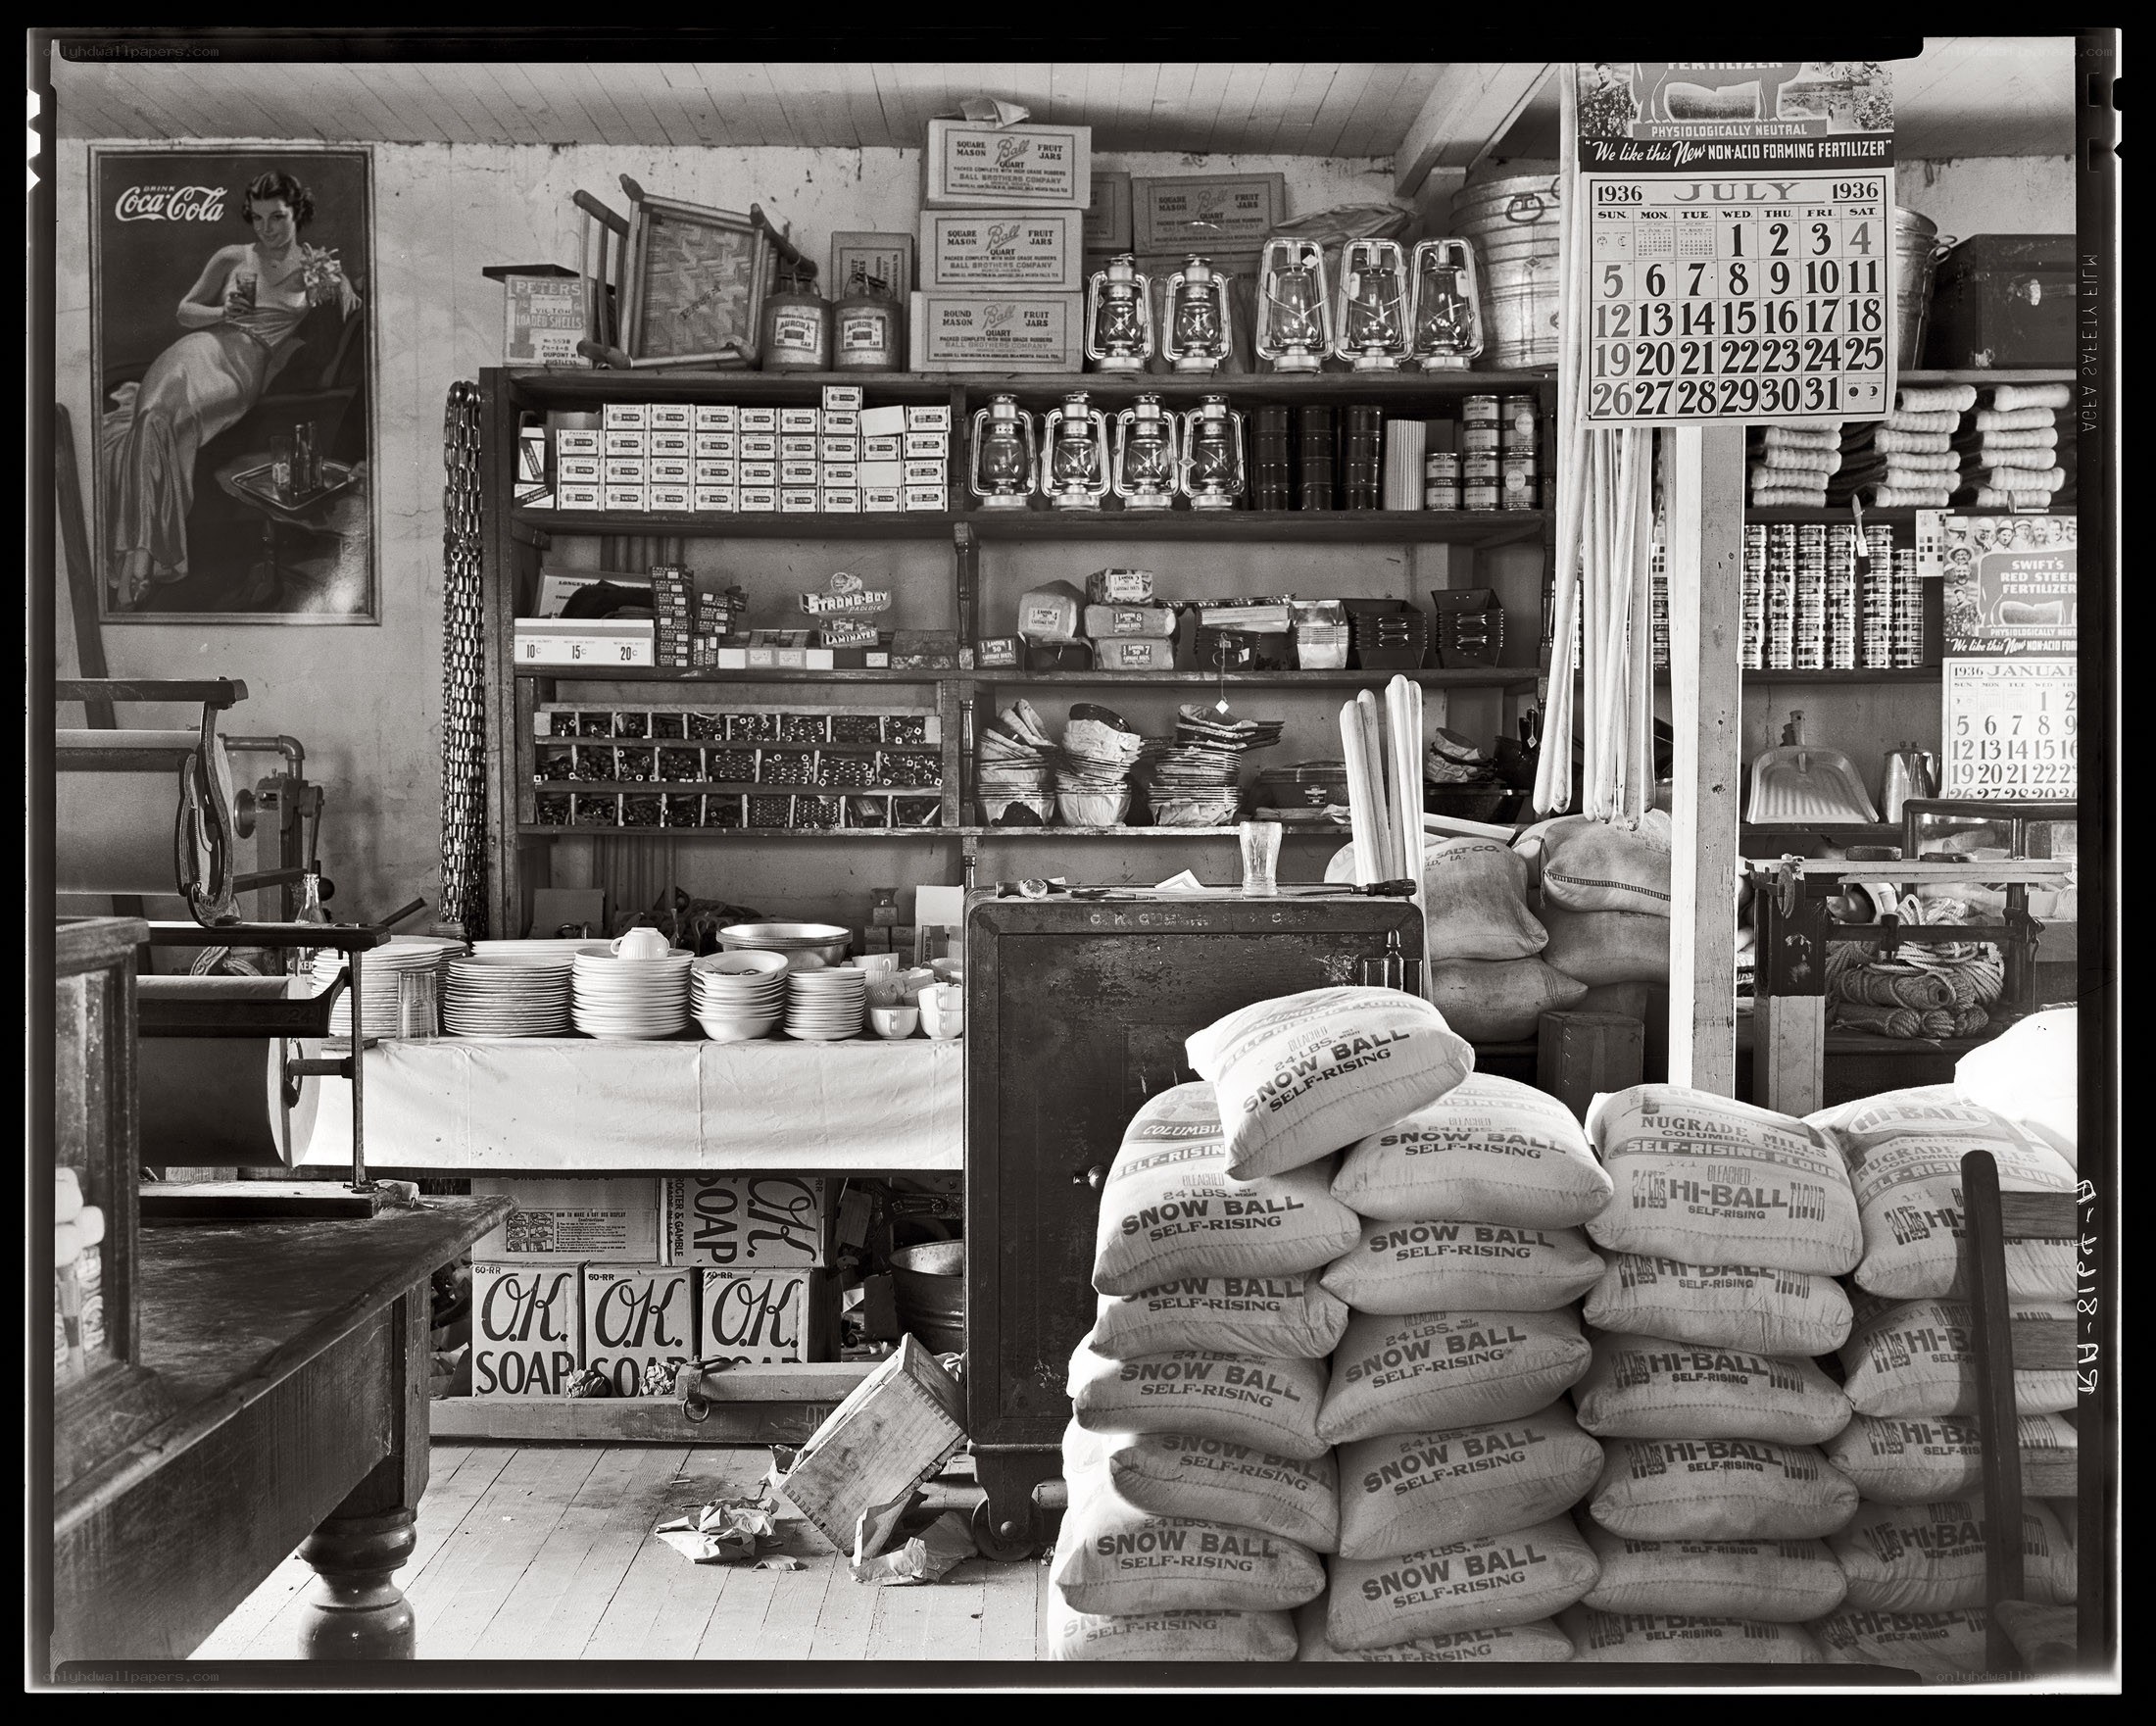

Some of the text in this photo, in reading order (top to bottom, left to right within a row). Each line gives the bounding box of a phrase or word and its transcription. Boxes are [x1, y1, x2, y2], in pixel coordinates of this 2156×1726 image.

[1651, 123, 1807, 138] PHYSIOLOGICALLY NEUTRAL
[995, 137, 1030, 165] Ball
[1619, 144, 1645, 162] like
[1645, 142, 1672, 161] this
[1671, 141, 1706, 167] New
[1763, 143, 1814, 159] FORMING
[115, 185, 227, 222] Coca-Cola
[1597, 182, 1879, 203] 1936 JULY 1936
[1732, 222, 1871, 257] 1 2 3 4
[516, 281, 581, 295] PETERS
[1603, 259, 1879, 298] 5 6 7 8 9 10 11
[516, 315, 583, 328] LOADED SHELLS
[779, 321, 811, 331] AURORA
[1595, 298, 1882, 338] 12 13 14 15 16 17 18
[1594, 337, 1884, 377] 19 20 21 22 23 24 25
[1592, 376, 1839, 417] 26 27 28 29 30 31
[2012, 557, 2064, 570] SWIFT'S
[2000, 572, 2077, 582] RED STEER
[2003, 584, 2077, 594] FERTILIZER
[824, 630, 876, 646] LAMINATED
[1968, 638, 1986, 651] like
[1986, 638, 2004, 651] this
[1954, 666, 1984, 676] 1936
[1957, 715, 2023, 735] 5 6 7
[1952, 740, 2029, 760] 12 13 14
[1436, 847, 1470, 859] SALT
[1243, 1029, 1410, 1113] SNOW BALL
[1269, 1048, 1391, 1112] SELF-RISING
[1380, 1132, 1567, 1154] SNOW BALL
[1642, 1116, 1828, 1159] NUGRADE MILLS
[1405, 1143, 1541, 1159] SELF-RISING
[1627, 1140, 1841, 1180] SELF-RISING FLOUR
[1707, 1164, 1750, 1185] BLEACHED
[1163, 1189, 1232, 1201] 24 LBS.
[1670, 1179, 1788, 1208] HI-BALL
[1121, 1196, 1304, 1235] SNOW BALL
[1689, 1205, 1766, 1219] SELF-RISING
[675, 1221, 684, 1257] GAMBLE
[1150, 1216, 1282, 1242] SELF-RISING
[481, 1273, 572, 1342] O.K.
[595, 1278, 686, 1349] O.K.
[712, 1277, 804, 1348] O.K.
[1345, 1326, 1527, 1383] SNOW BALL
[1648, 1353, 1769, 1376] HI-BALL
[476, 1351, 575, 1395] SOAP
[1372, 1349, 1504, 1389] SELF-RISING
[1672, 1372, 1748, 1385] SELF-RISING
[1665, 1442, 1783, 1466] HI-BALL
[1688, 1461, 1764, 1472] SELF-RISING
[1361, 1545, 1547, 1601] SNOW BALL
[1393, 1571, 1526, 1608] SELF-RISING
